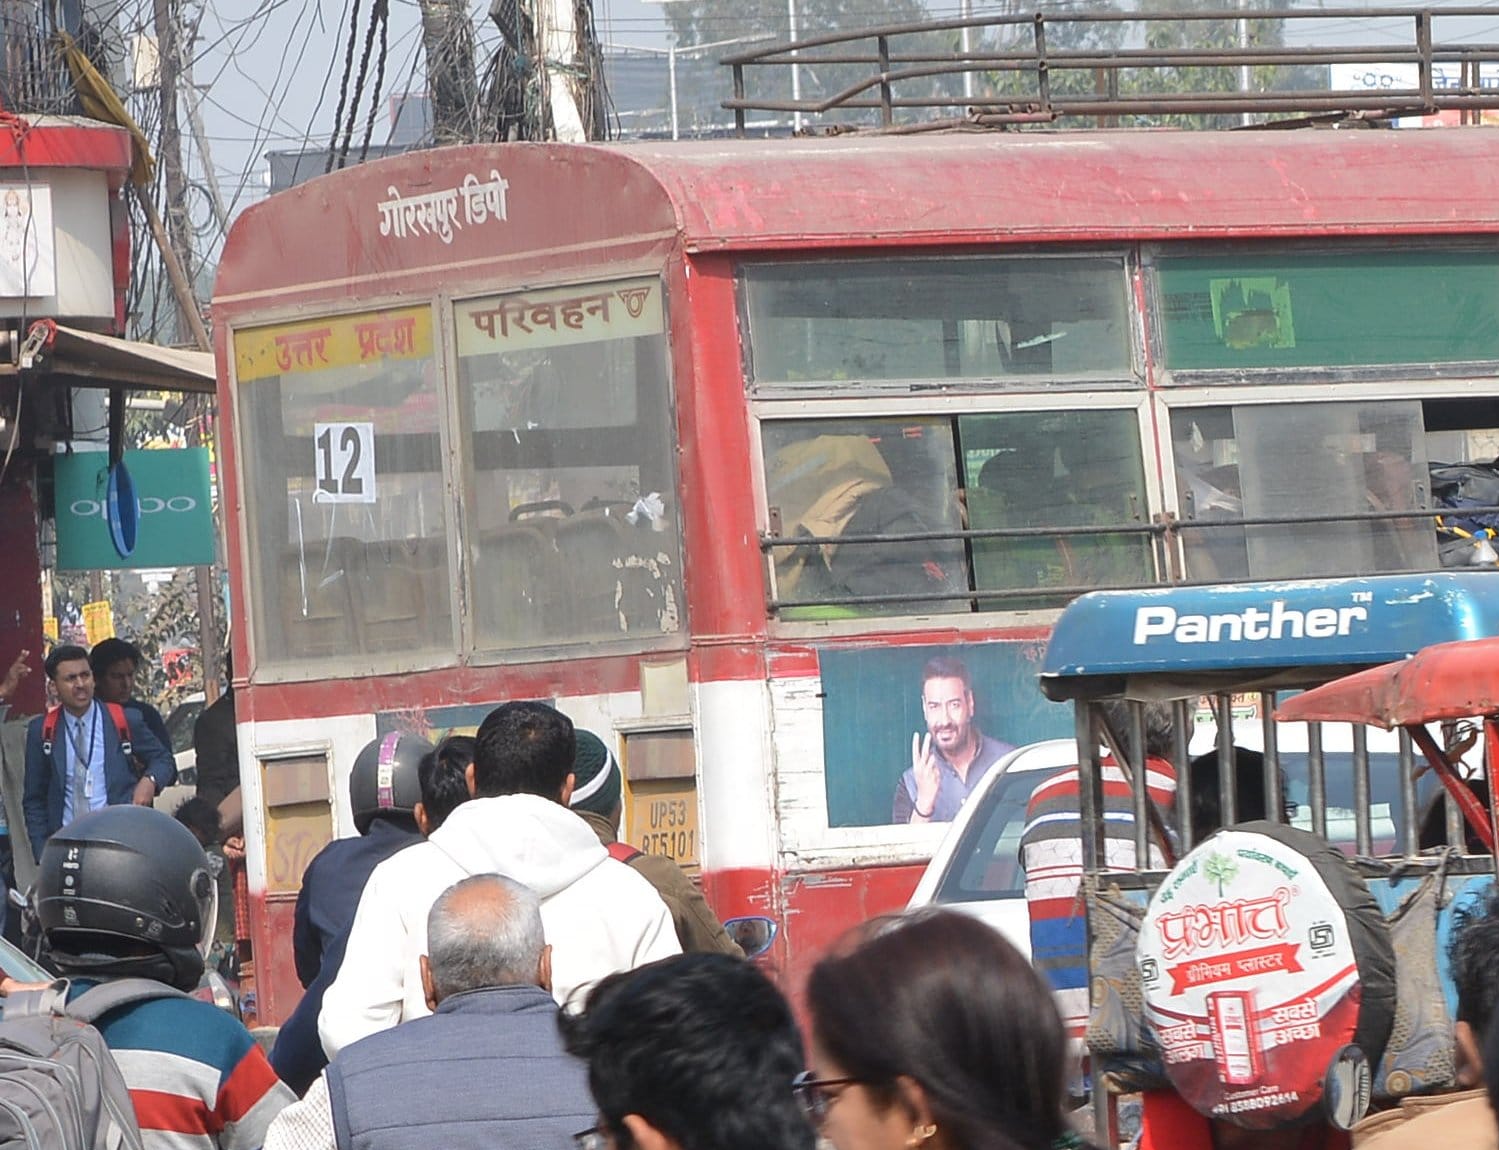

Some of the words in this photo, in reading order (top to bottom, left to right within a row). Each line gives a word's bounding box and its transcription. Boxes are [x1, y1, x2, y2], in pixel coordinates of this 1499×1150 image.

[378, 186, 461, 243] गोरखपुर
[462, 170, 512, 225] डिपो
[469, 291, 615, 339] परिवहन
[275, 327, 332, 371] उत्तर
[317, 426, 363, 495] 12
[1133, 601, 1369, 645] Panther
[651, 800, 686, 828] UP53
[1156, 886, 1291, 960] प्रभात
[1236, 952, 1284, 974] प्लास्टर
[1160, 1019, 1198, 1046] सबसे
[1273, 999, 1319, 1025] सबसे
[1274, 1022, 1321, 1045] अच्छा
